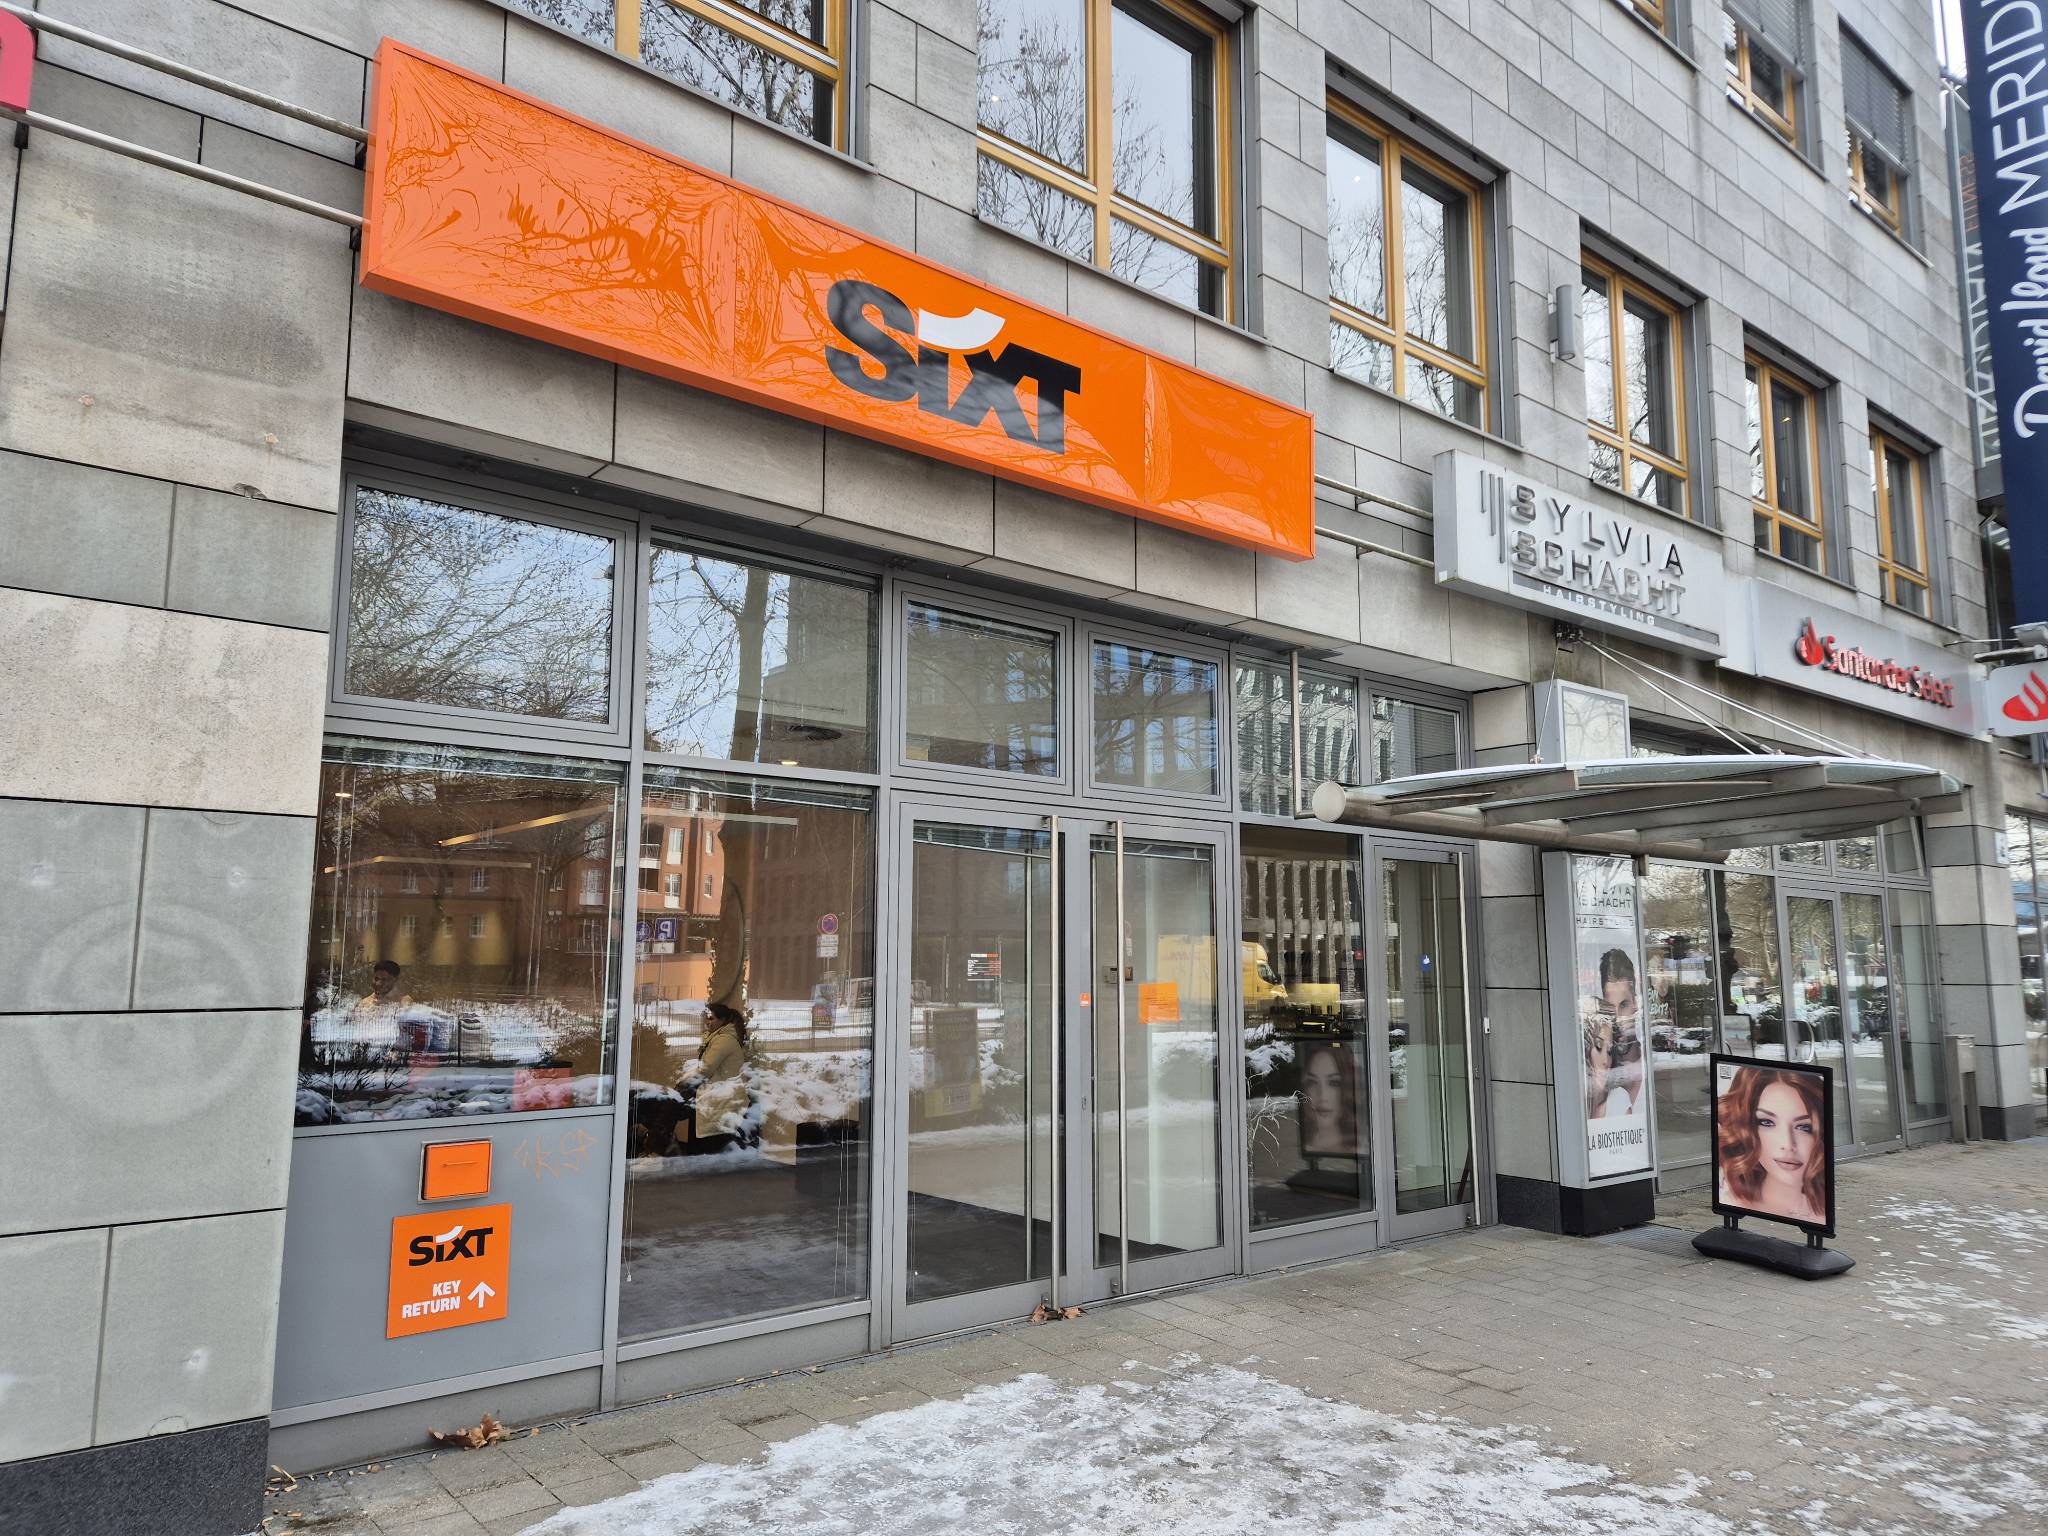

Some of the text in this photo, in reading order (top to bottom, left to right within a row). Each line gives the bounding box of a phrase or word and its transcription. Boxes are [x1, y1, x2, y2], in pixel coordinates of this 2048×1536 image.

[1981, 0, 2048, 215] MERID
[1511, 484, 1684, 576] SYLVIA
[1511, 530, 1686, 615] SCHACHT
[1543, 584, 1656, 625] HAIRSTYLING
[1588, 1135, 1597, 1151] LA
[402, 1296, 461, 1319] RETURN
[432, 1279, 462, 1297] KEY
